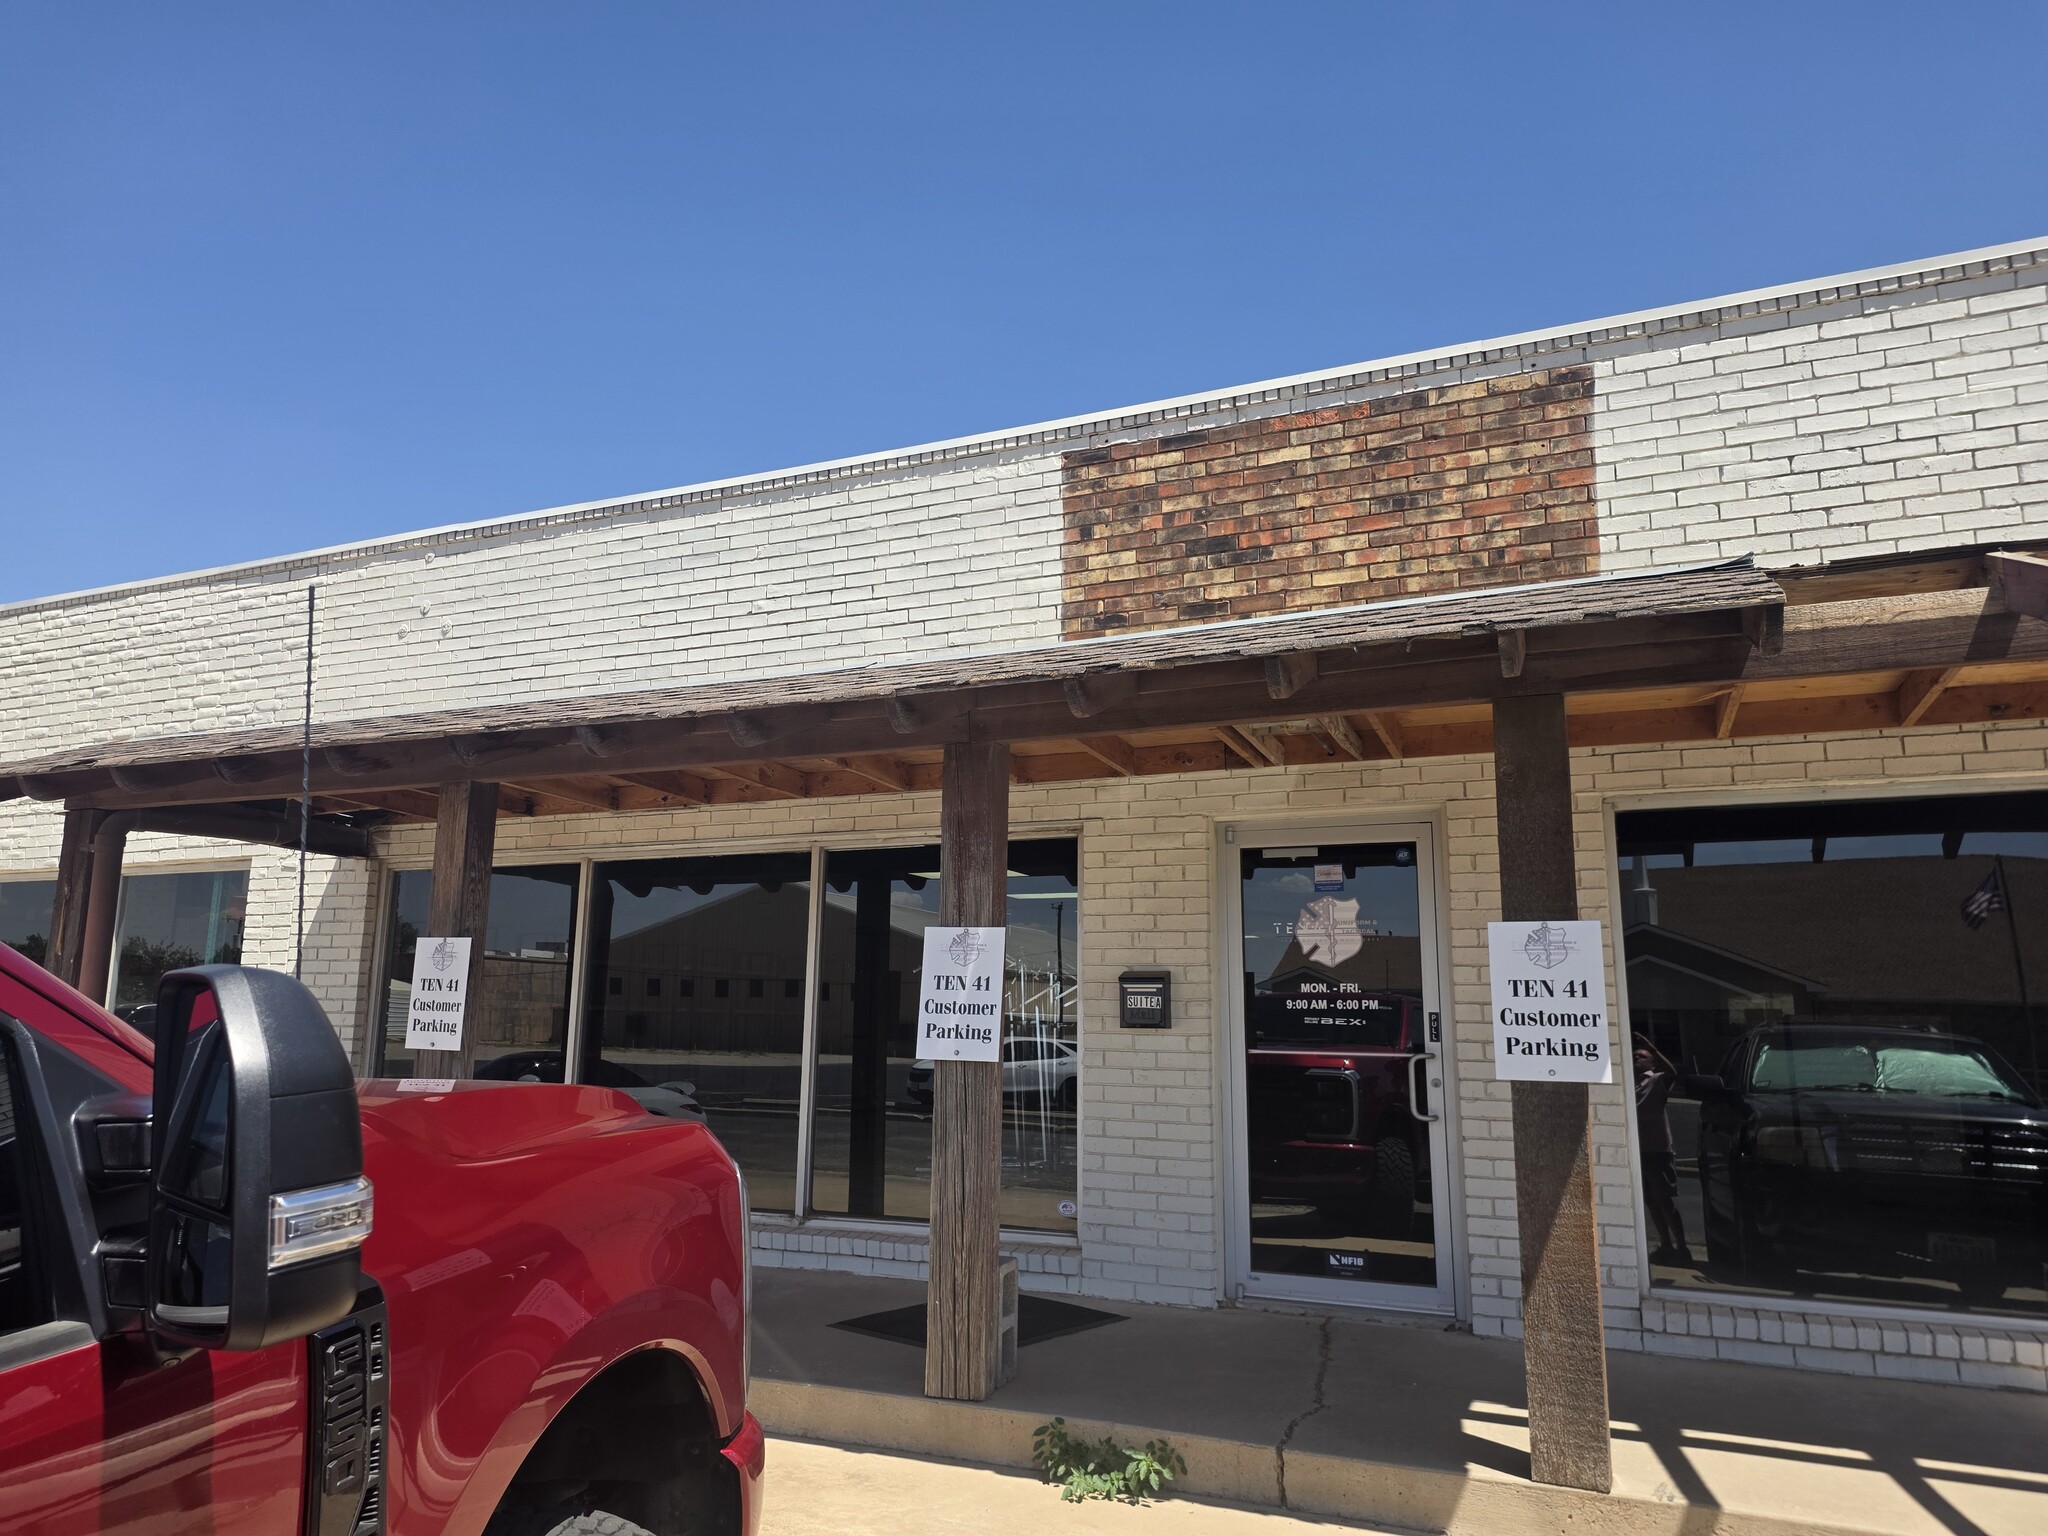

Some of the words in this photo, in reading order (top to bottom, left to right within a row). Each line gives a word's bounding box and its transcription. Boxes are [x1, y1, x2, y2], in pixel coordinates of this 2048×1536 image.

[420, 978, 444, 992] TEN
[446, 978, 459, 992] 41
[933, 975, 968, 991] TEN
[972, 975, 991, 991] 41
[1300, 983, 1330, 993] MON.
[1339, 983, 1362, 993] FRI.
[1507, 979, 1555, 998] TEN
[1562, 979, 1589, 998] 41
[412, 998, 462, 1013] Customer
[924, 998, 997, 1016] Customer
[1286, 999, 1308, 1010] 9:00
[1310, 999, 1328, 1010] AM
[1336, 999, 1359, 1010] 6:00
[1361, 999, 1379, 1010] PM
[1499, 1007, 1601, 1028] Customer
[412, 1018, 457, 1036] Parking
[925, 1022, 992, 1044] Parking
[1505, 1036, 1600, 1062] Parking
[1341, 1256, 1364, 1266] NFIB
